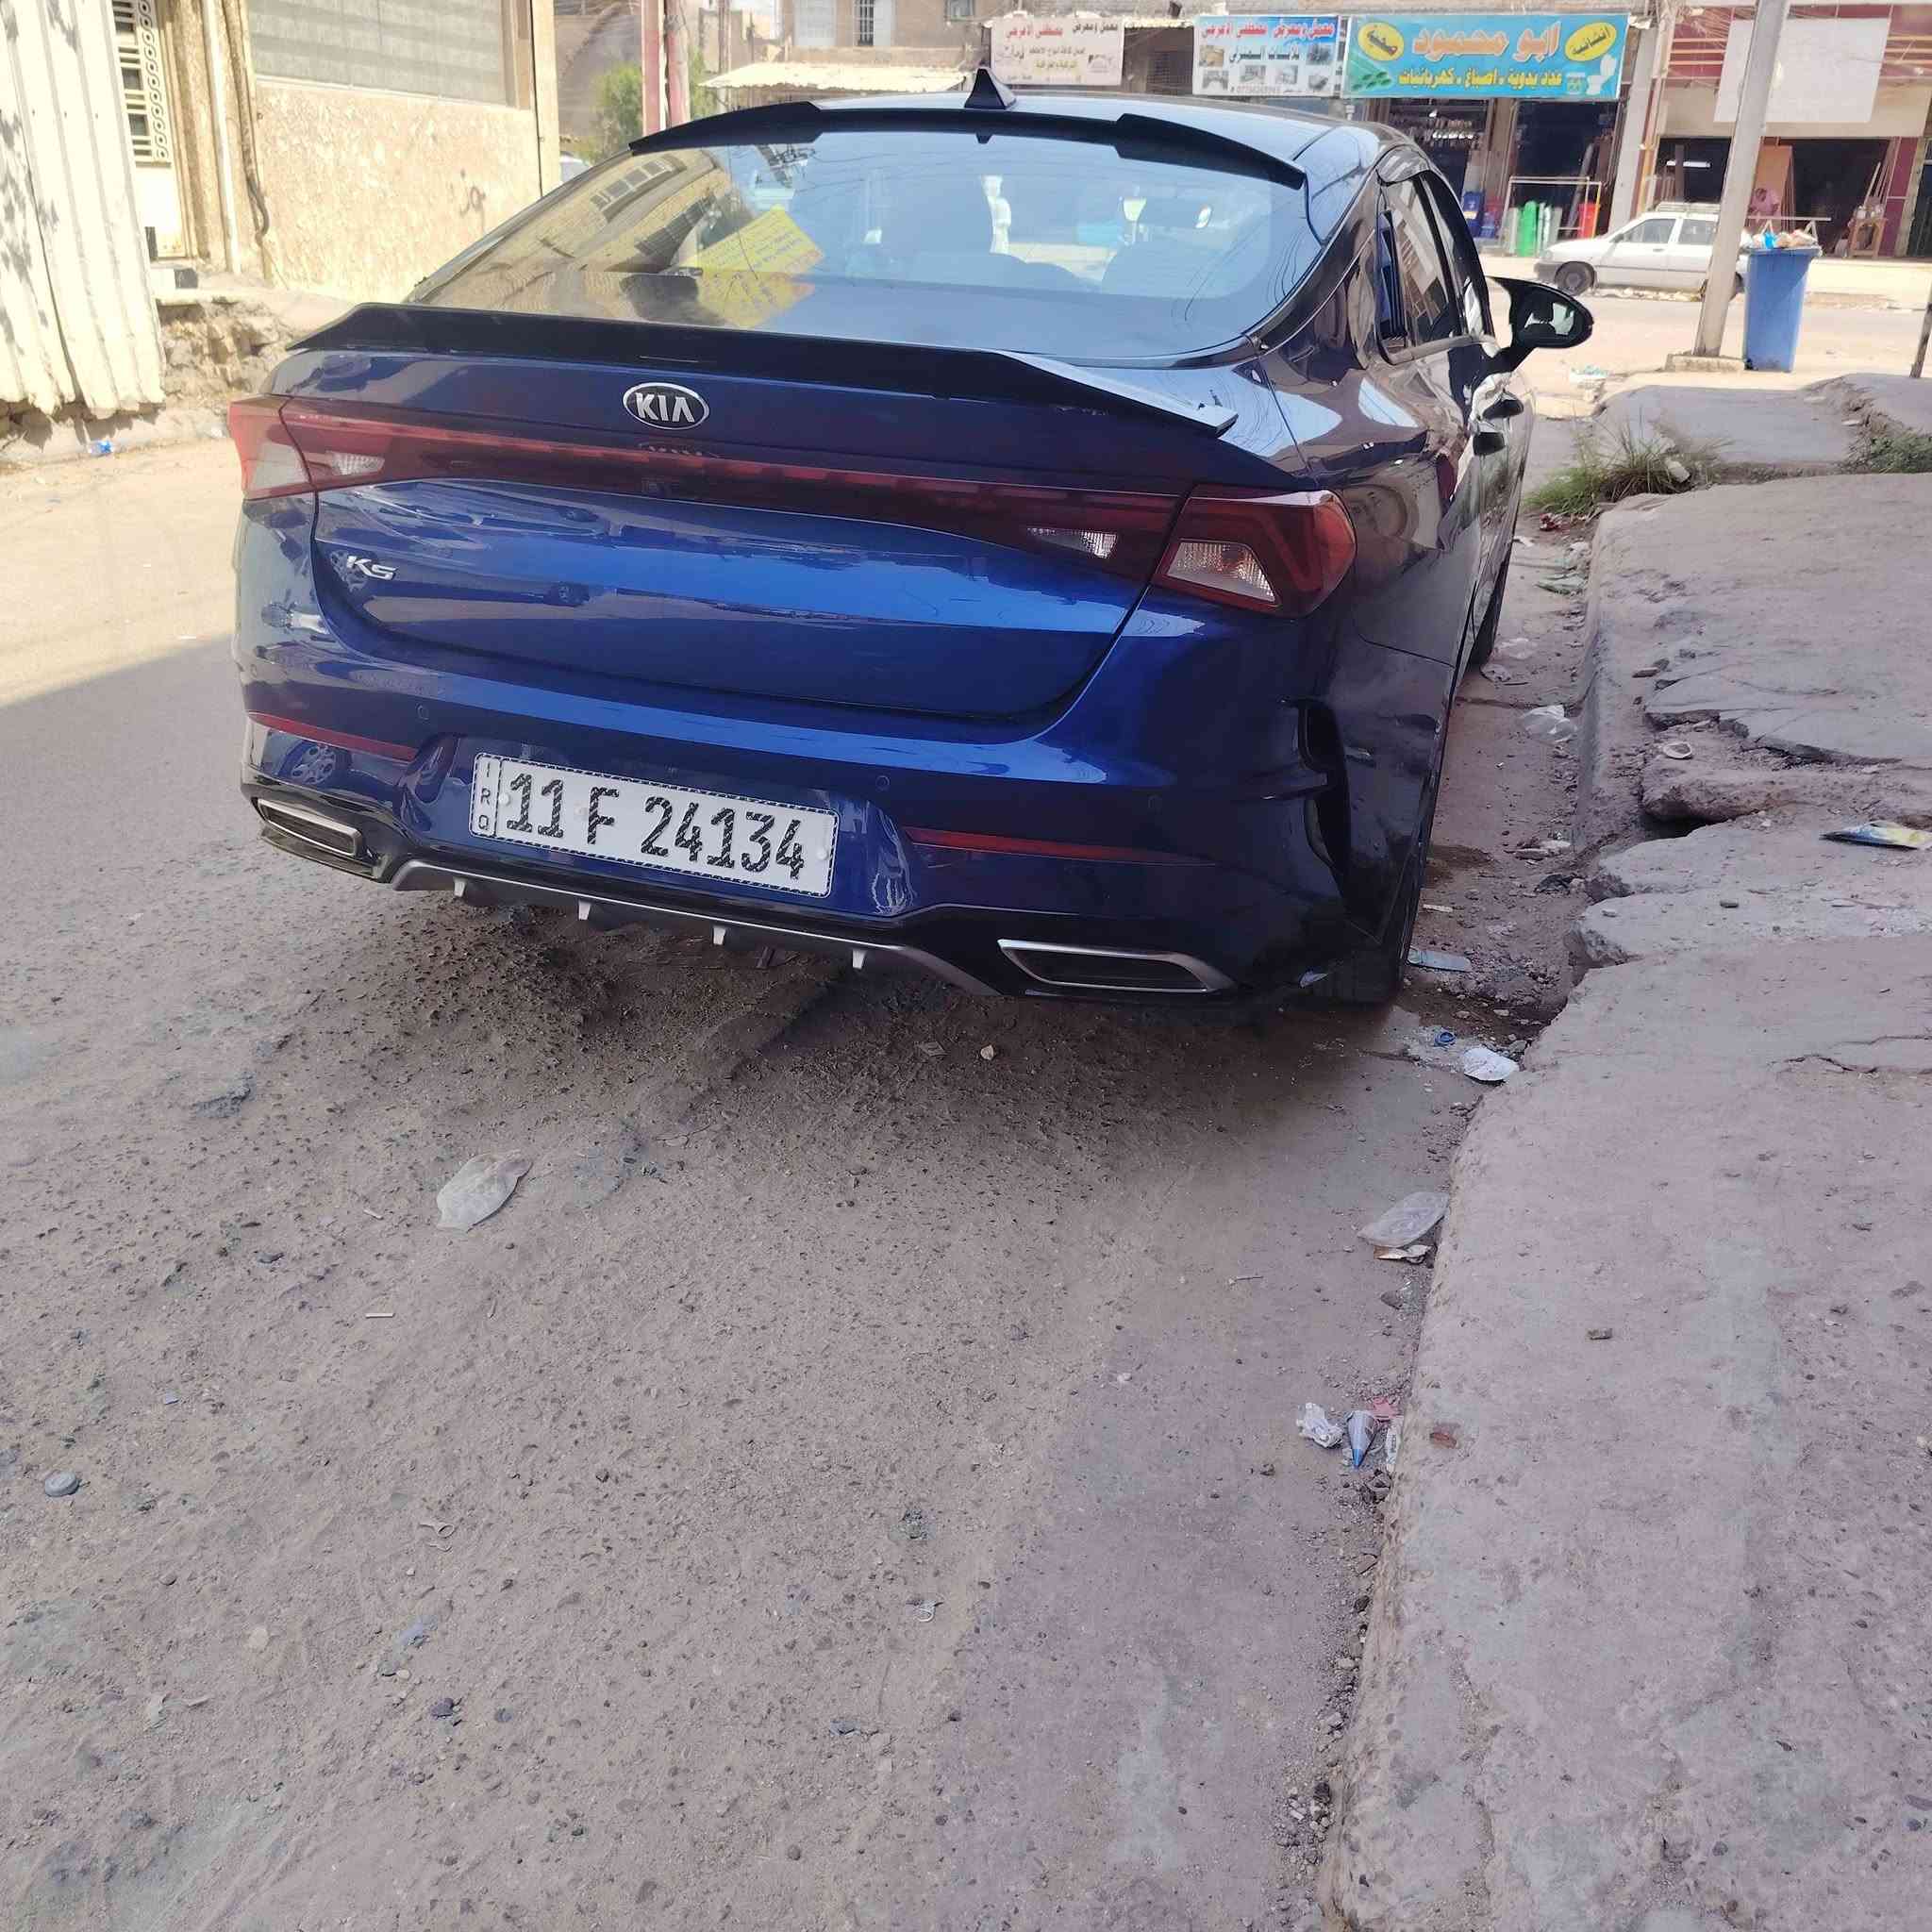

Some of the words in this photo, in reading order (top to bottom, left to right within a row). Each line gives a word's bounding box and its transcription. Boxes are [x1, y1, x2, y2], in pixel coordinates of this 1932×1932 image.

[1411, 27, 1510, 62] محمود
[1512, 20, 1562, 63] ابو
[1463, 67, 1498, 91] اصباغ
[1507, 68, 1539, 91] يدوية
[1540, 69, 1563, 87] عدد
[634, 391, 695, 423] KIA
[346, 555, 397, 581] K5
[477, 761, 491, 831] IRQ
[507, 773, 564, 839] 11
[587, 785, 620, 845] F
[641, 795, 806, 880] 24134
